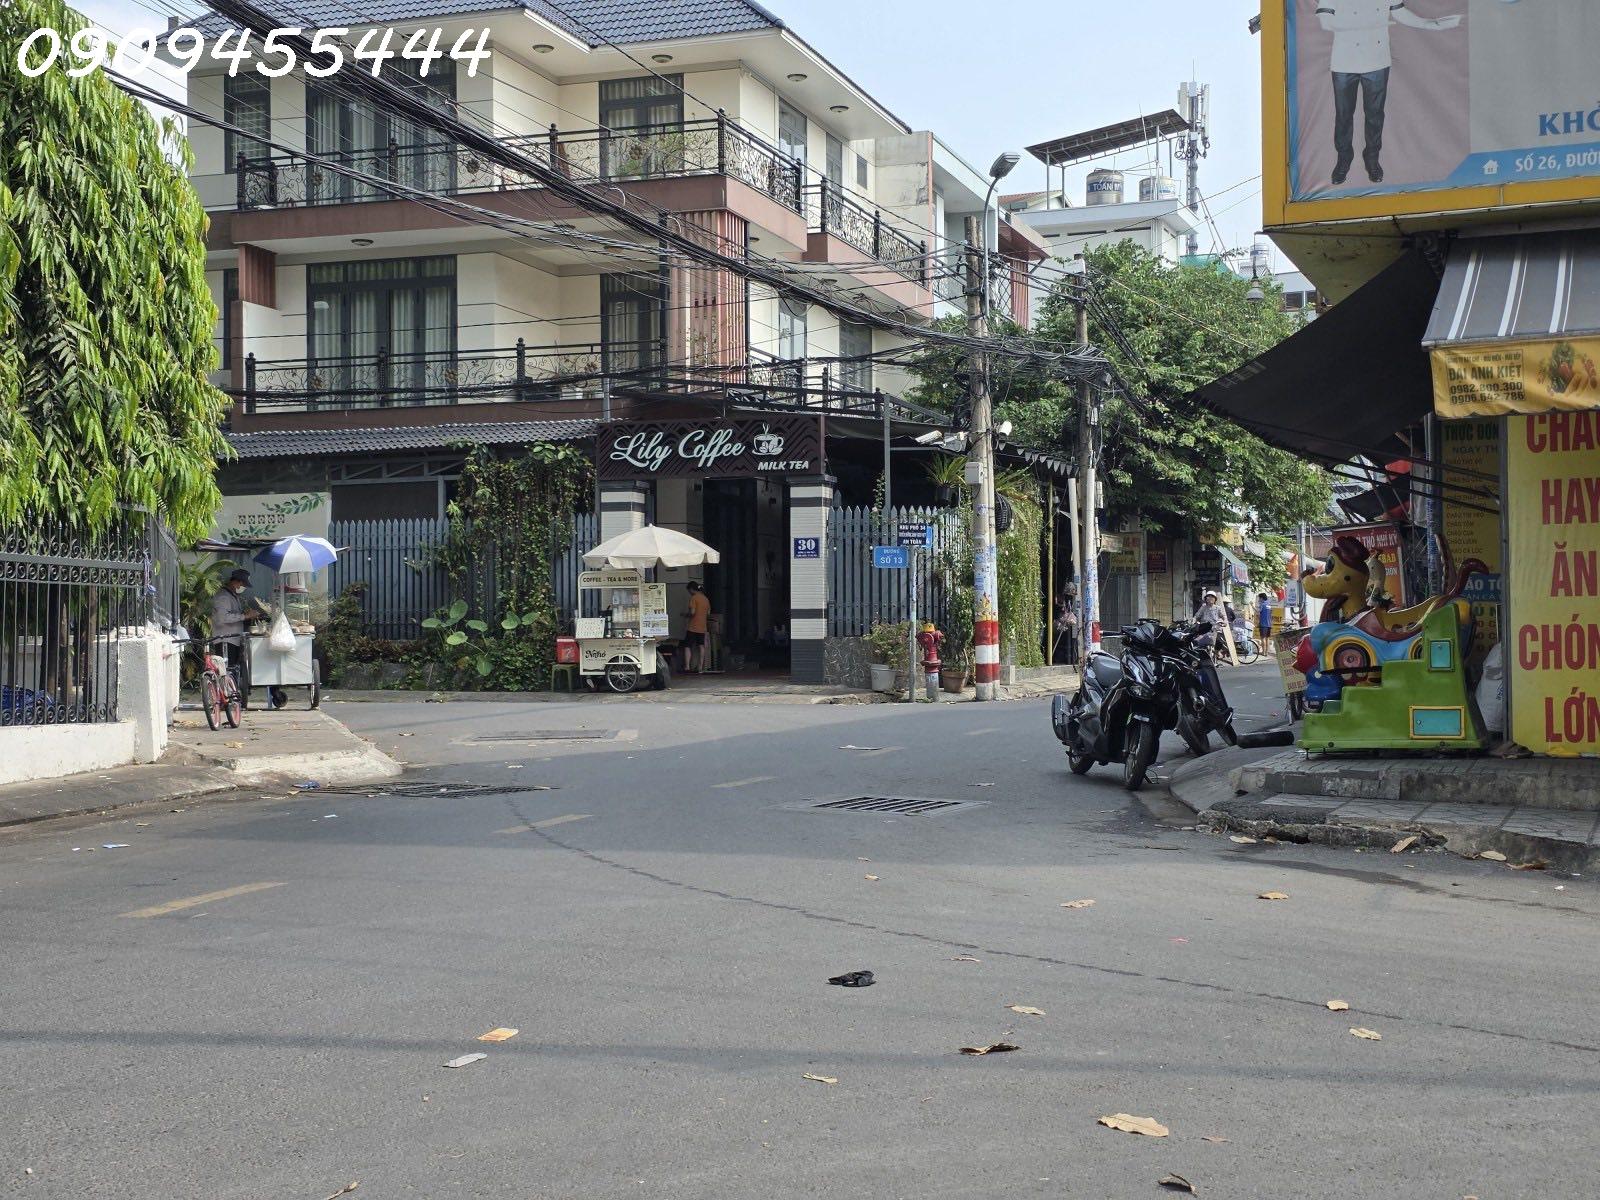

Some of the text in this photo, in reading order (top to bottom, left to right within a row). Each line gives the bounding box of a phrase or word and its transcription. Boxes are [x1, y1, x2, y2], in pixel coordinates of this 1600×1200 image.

[1515, 148, 1600, 172] SỐ 26, ĐƯỜ
[1471, 366, 1494, 380] ANH
[1497, 362, 1522, 380] KIỆT
[610, 428, 746, 472] Lily Coffee
[757, 460, 809, 471] MILK TEA
[1541, 477, 1600, 525] HAY
[797, 538, 816, 551] 30
[1550, 540, 1598, 597] ĂN
[1545, 686, 1600, 744] LỚN
